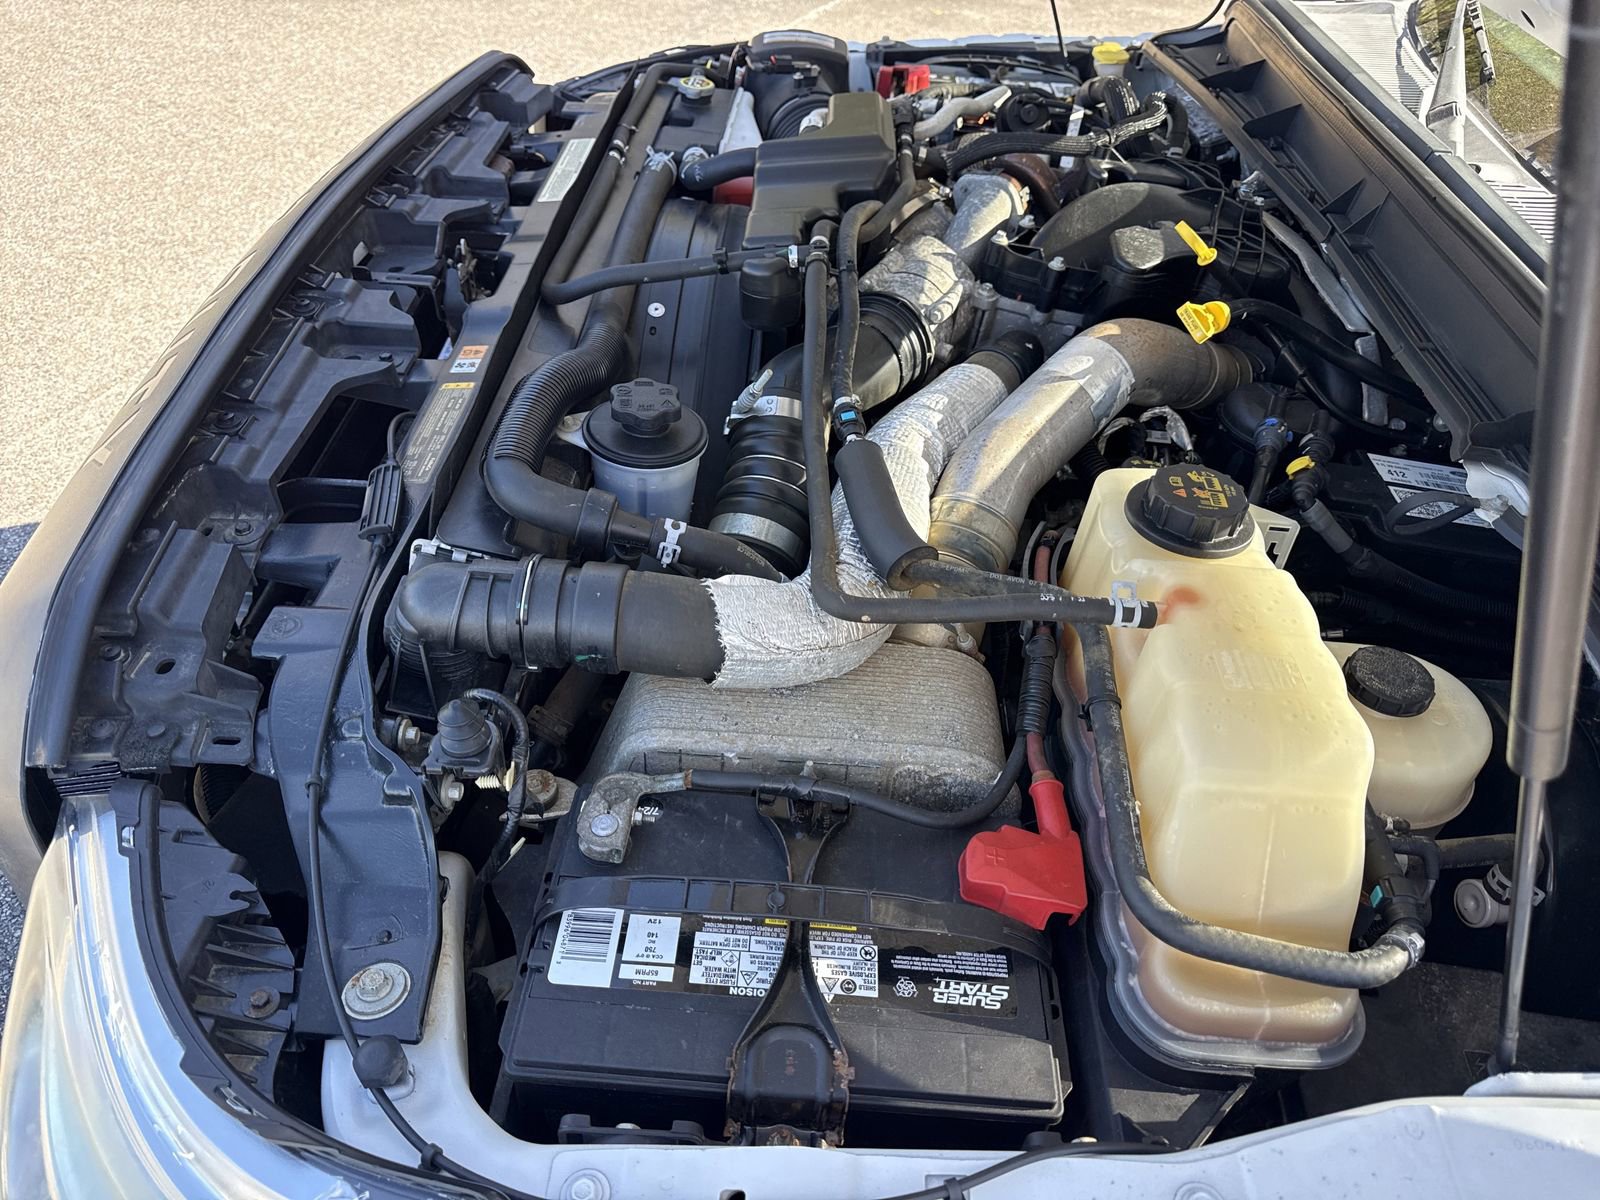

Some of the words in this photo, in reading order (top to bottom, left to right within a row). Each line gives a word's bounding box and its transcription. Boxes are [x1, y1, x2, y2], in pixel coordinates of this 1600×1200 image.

[1387, 469, 1408, 479] 412
[635, 968, 659, 977] 65PRM
[701, 971, 736, 979] IMMEDIATELY
[729, 986, 765, 997] OISON
[933, 980, 1009, 1000] START
[933, 992, 1001, 1010] SUPER
